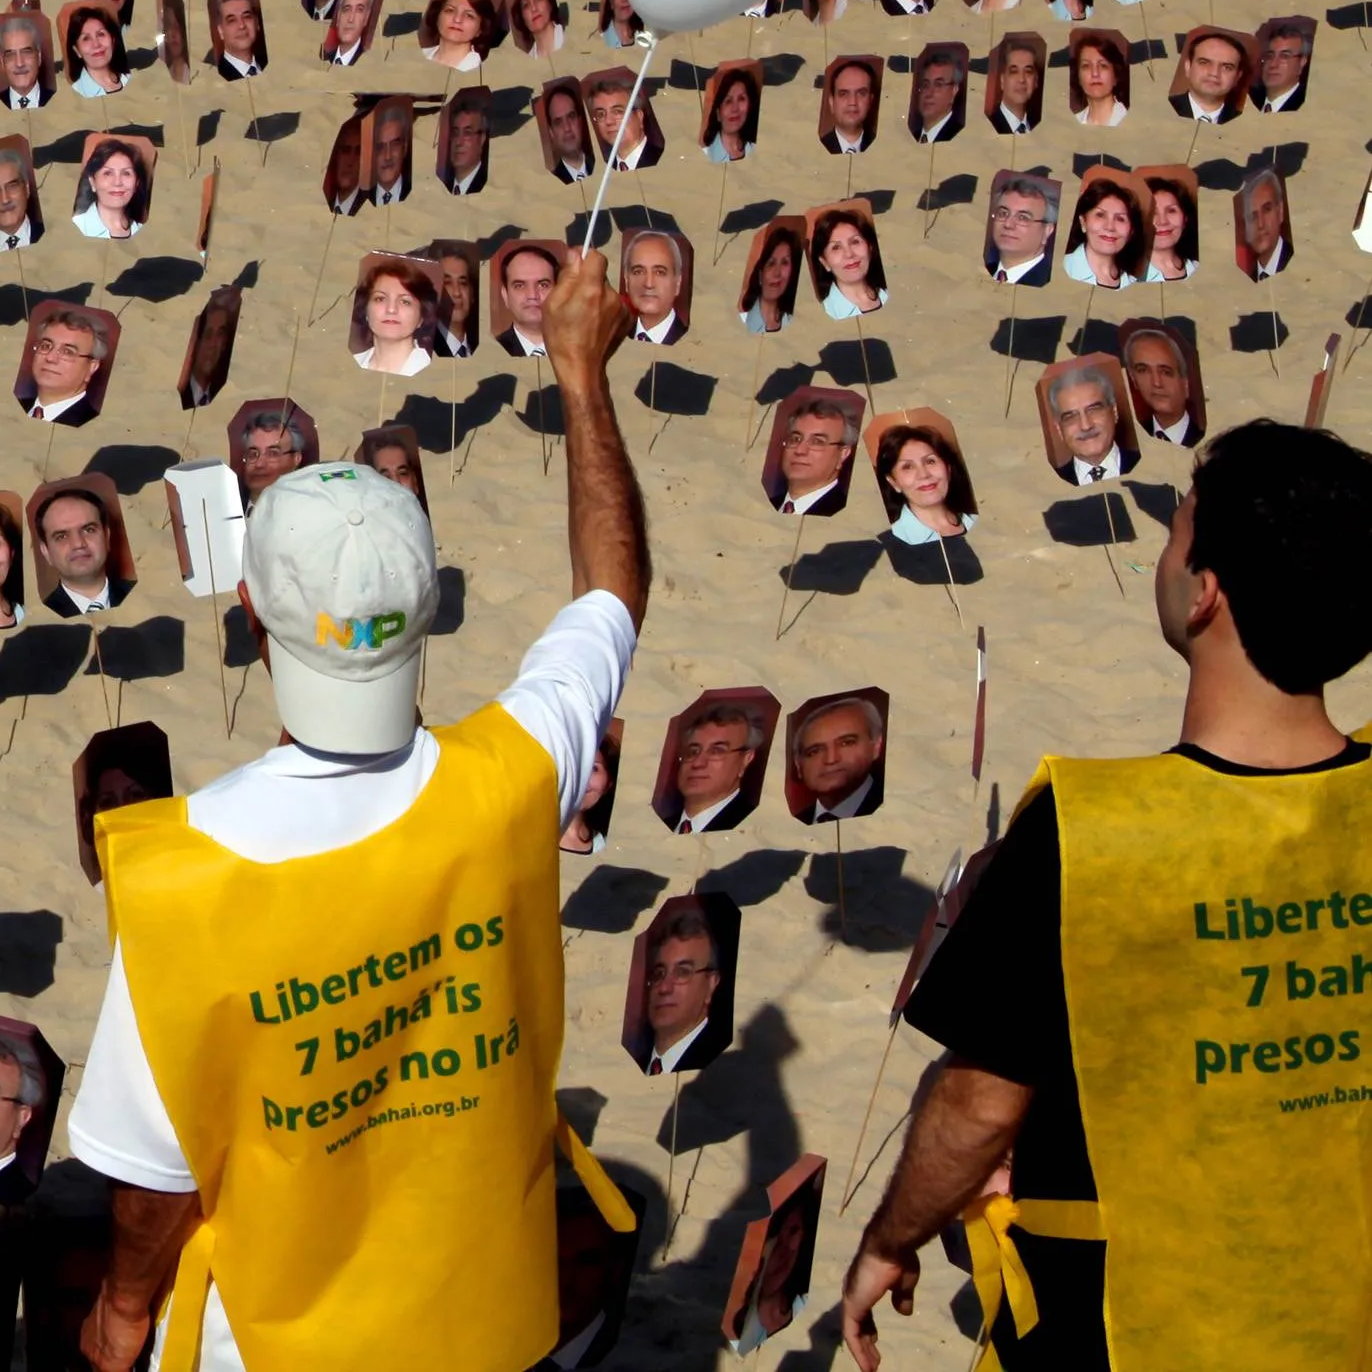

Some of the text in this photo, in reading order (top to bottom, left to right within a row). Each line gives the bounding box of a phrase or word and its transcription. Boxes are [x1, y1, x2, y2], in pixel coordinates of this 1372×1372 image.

[314, 611, 406, 651] NXP
[249, 915, 504, 1025] Libertem os
[1241, 964, 1270, 1007] 7
[262, 1016, 520, 1131] presos no Irã
[295, 1036, 320, 1076] 7
[1195, 1030, 1360, 1084] presos
[325, 1094, 481, 1155] www.bahai.org.br
